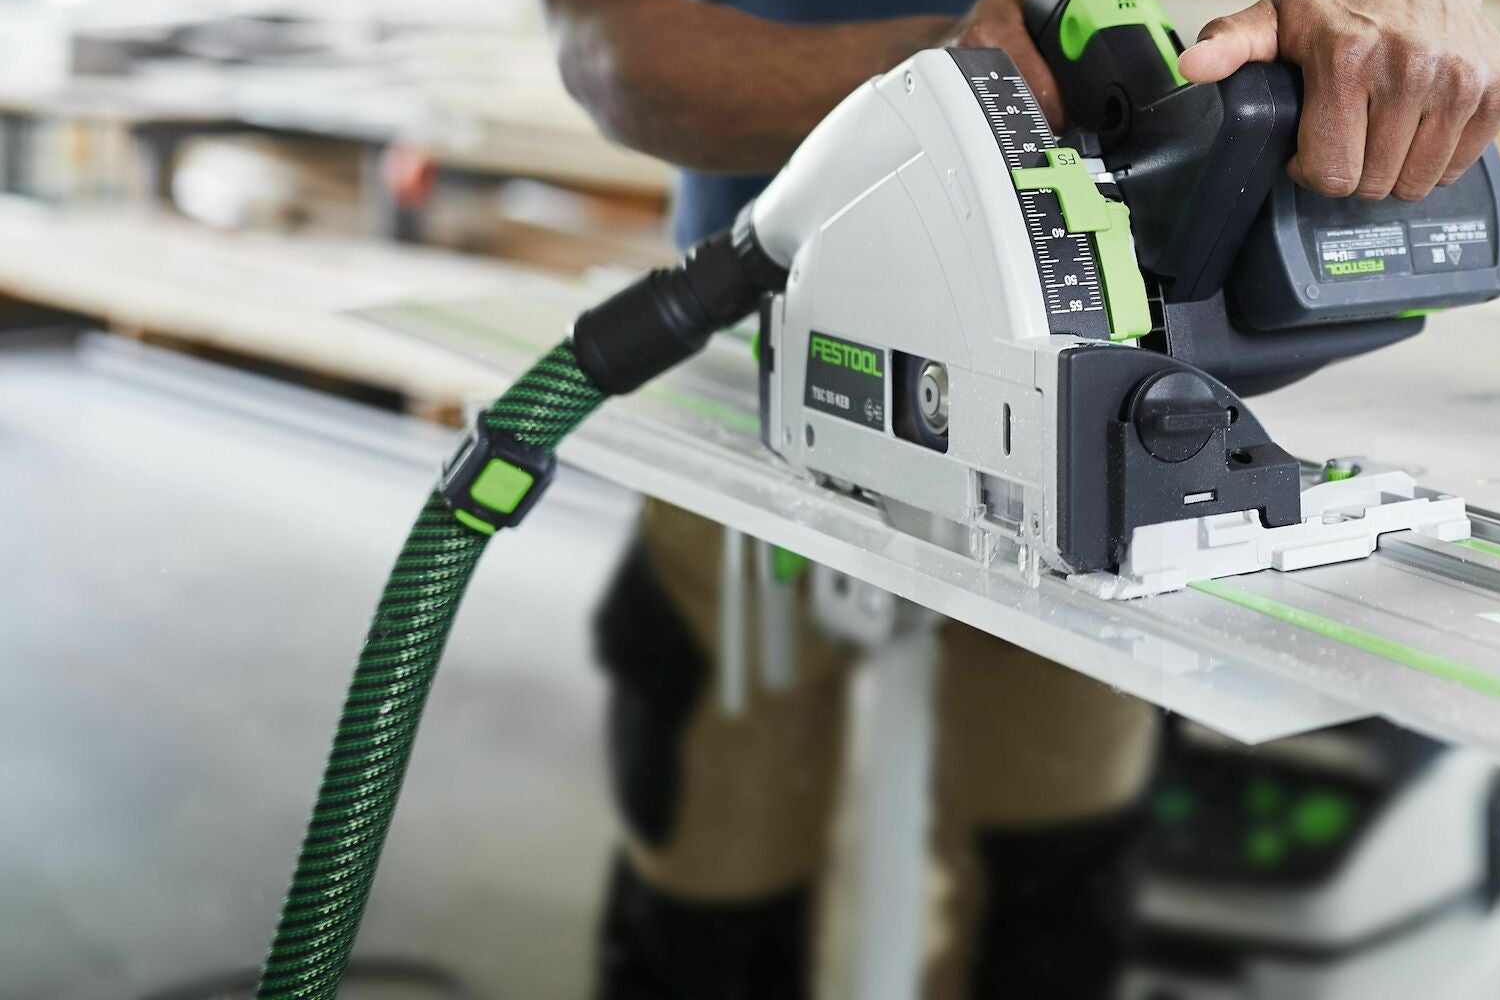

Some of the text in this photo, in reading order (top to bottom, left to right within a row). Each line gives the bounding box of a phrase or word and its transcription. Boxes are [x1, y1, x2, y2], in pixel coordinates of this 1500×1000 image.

[989, 71, 999, 80] 0
[1006, 105, 1020, 115] 10
[1023, 142, 1037, 152] 20
[1057, 153, 1076, 165] FS
[1051, 227, 1065, 238] 40
[1325, 260, 1384, 275] FESTOOL
[1064, 274, 1077, 286] 50
[1069, 300, 1083, 312] 55
[812, 336, 883, 378] FESTOOL
